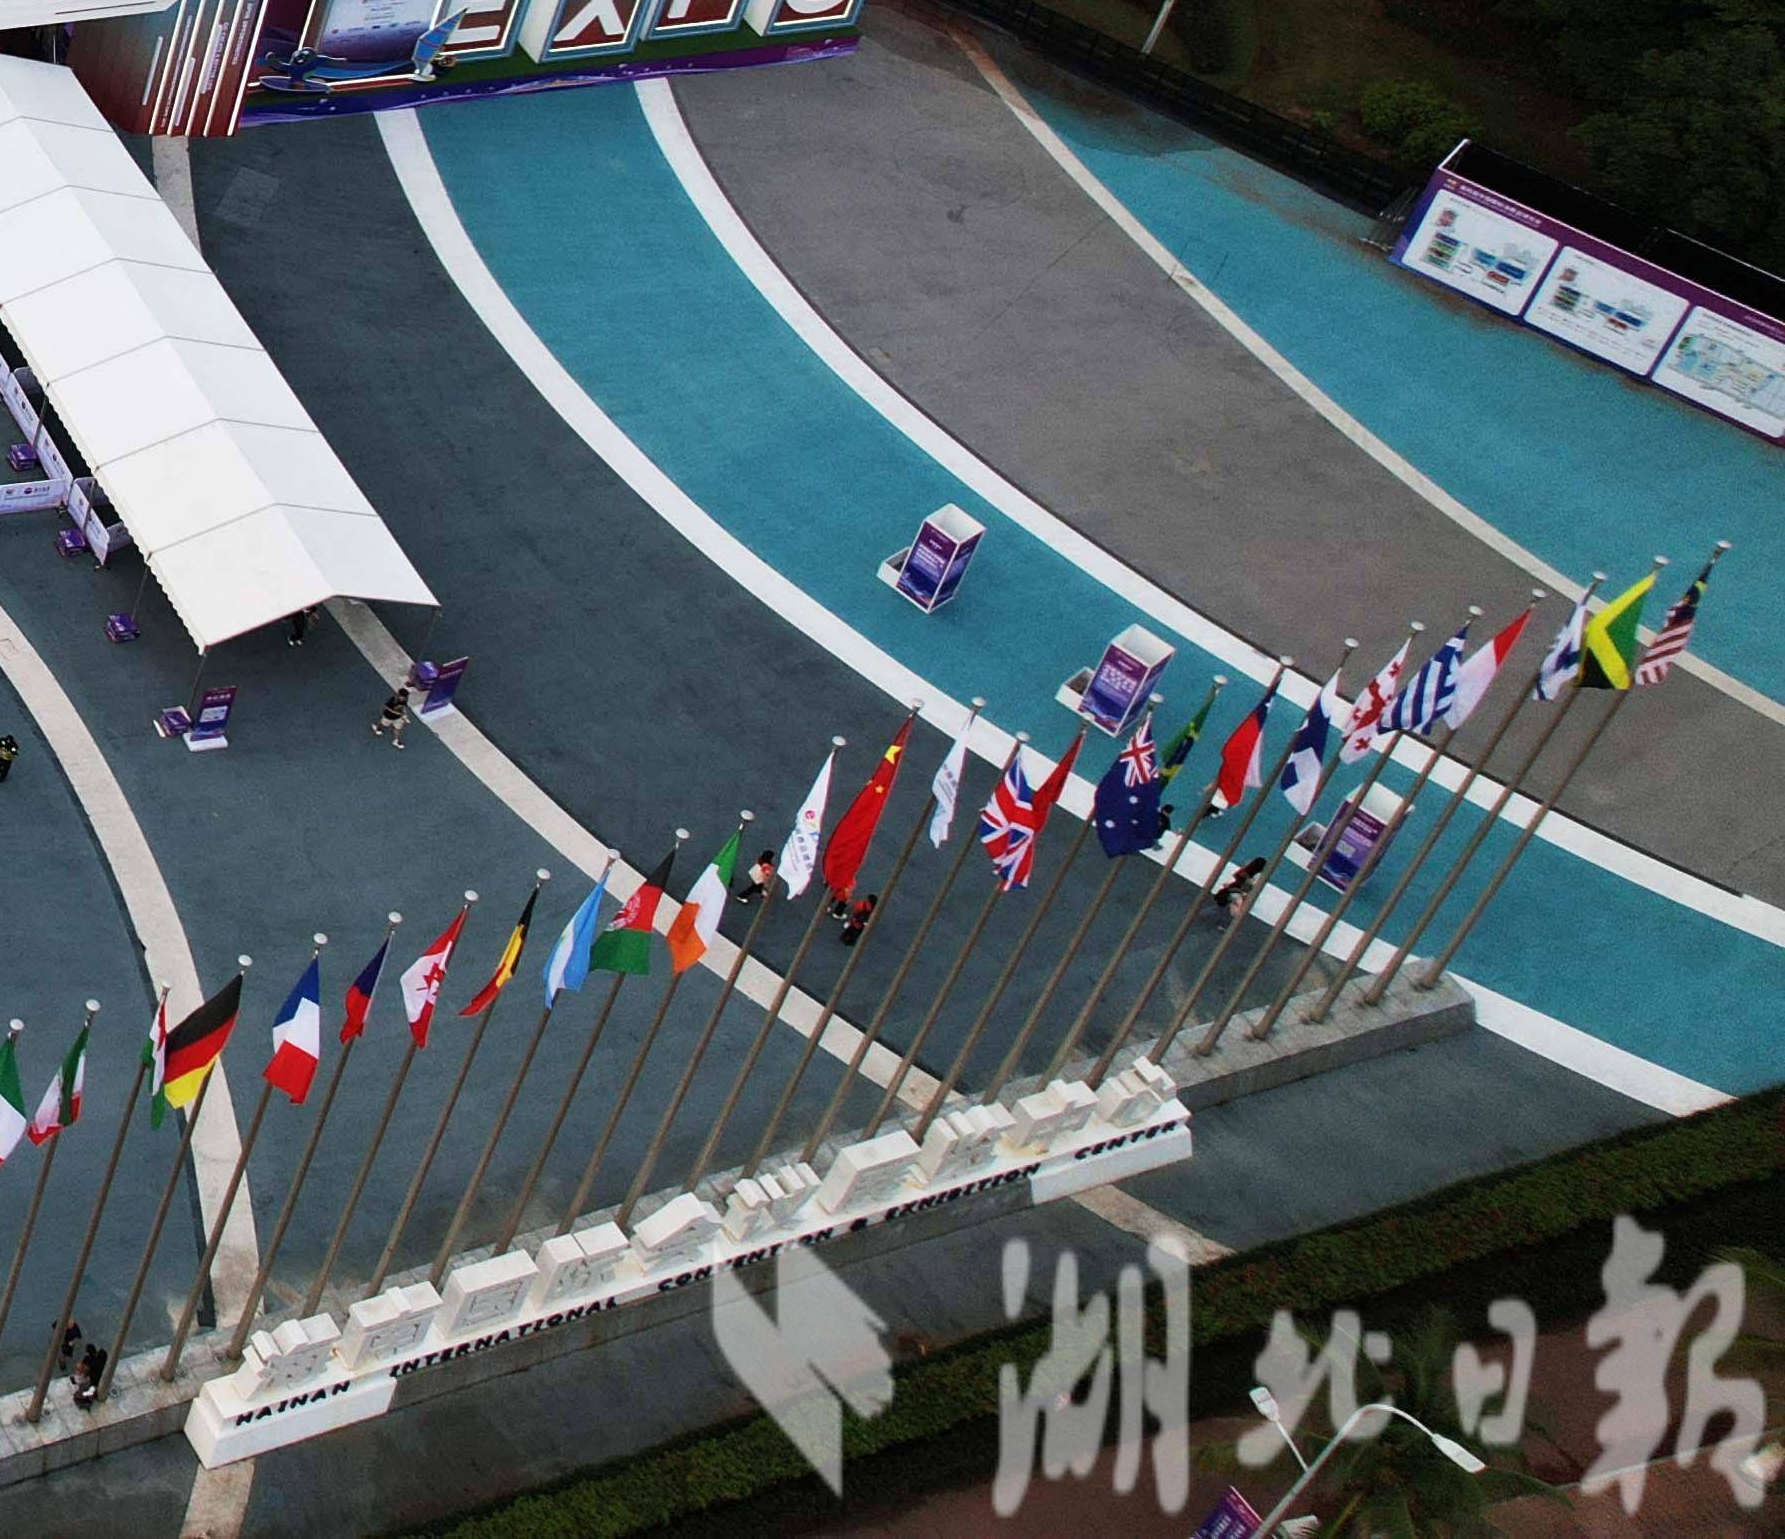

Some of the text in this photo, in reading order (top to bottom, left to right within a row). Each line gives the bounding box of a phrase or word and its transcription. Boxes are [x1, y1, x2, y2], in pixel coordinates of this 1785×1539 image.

[235, 1379, 351, 1427] HAINAN
[389, 1297, 618, 1377] INTERNATIONAL
[885, 1163, 1041, 1222] EXHIBITION
[1074, 1119, 1178, 1161] CENTER
